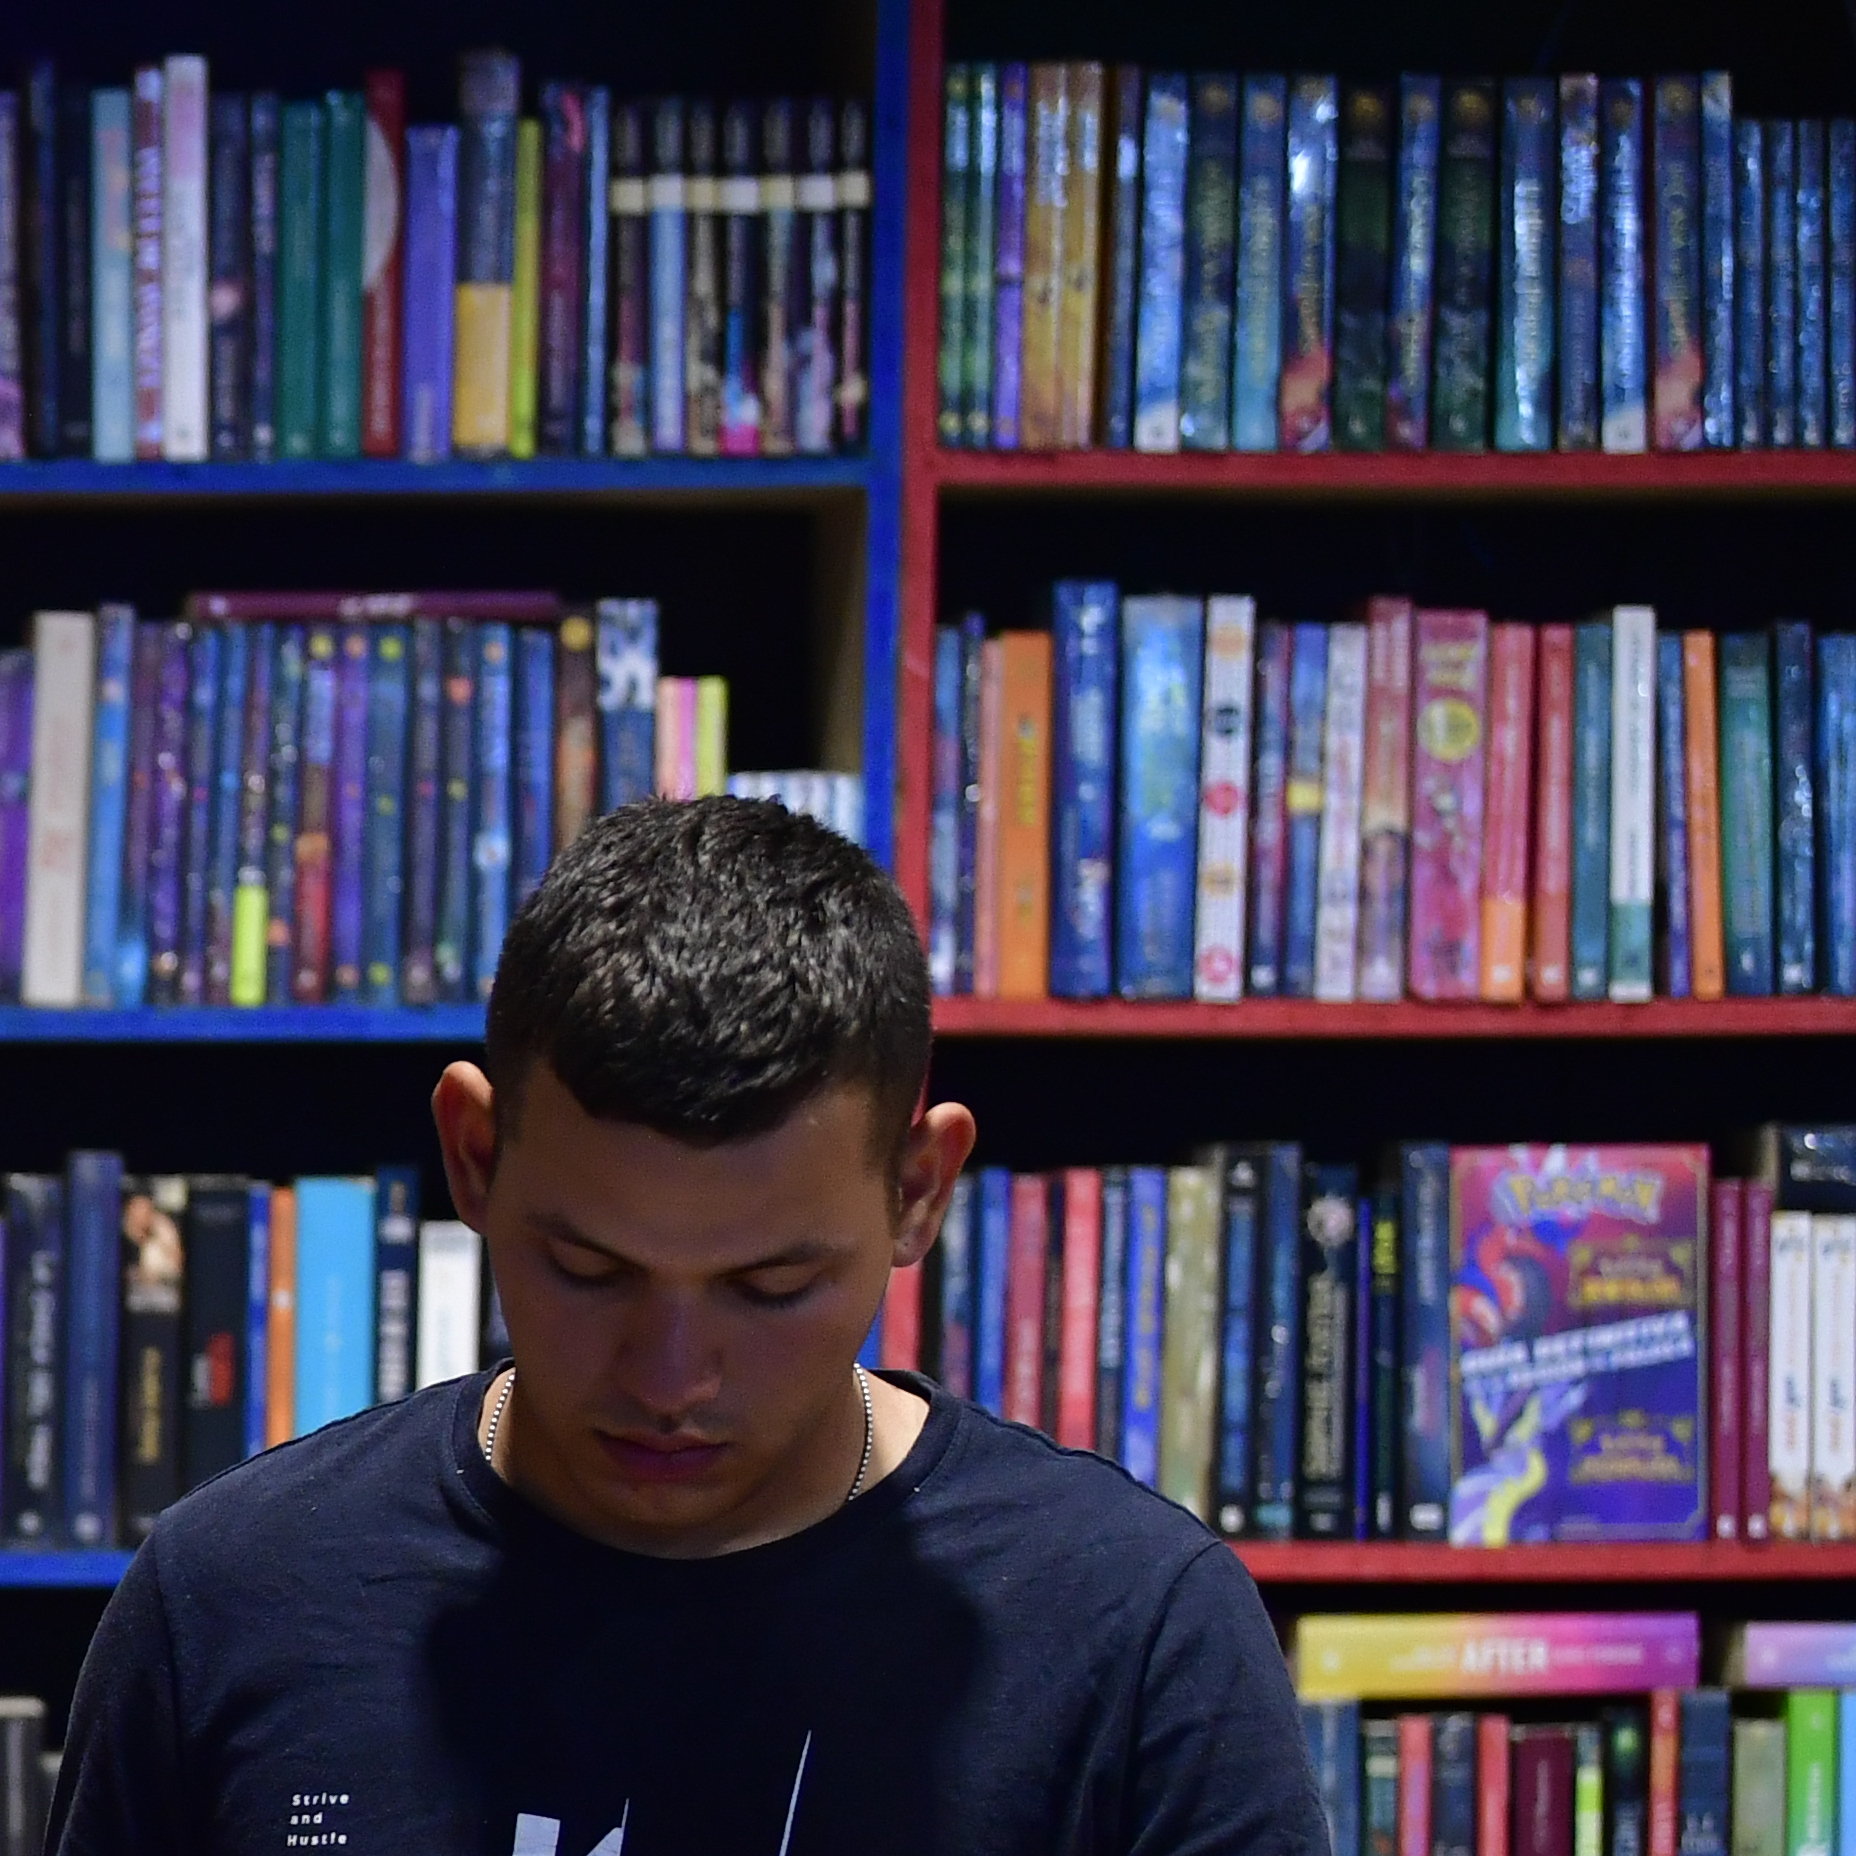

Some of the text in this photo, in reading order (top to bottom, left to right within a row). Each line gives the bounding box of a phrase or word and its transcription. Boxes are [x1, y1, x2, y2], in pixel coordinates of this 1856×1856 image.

[1461, 1636, 1549, 1675] AFTER
[292, 1792, 350, 1807] Strive
[290, 1812, 323, 1826] and
[287, 1832, 348, 1848] Hustle
